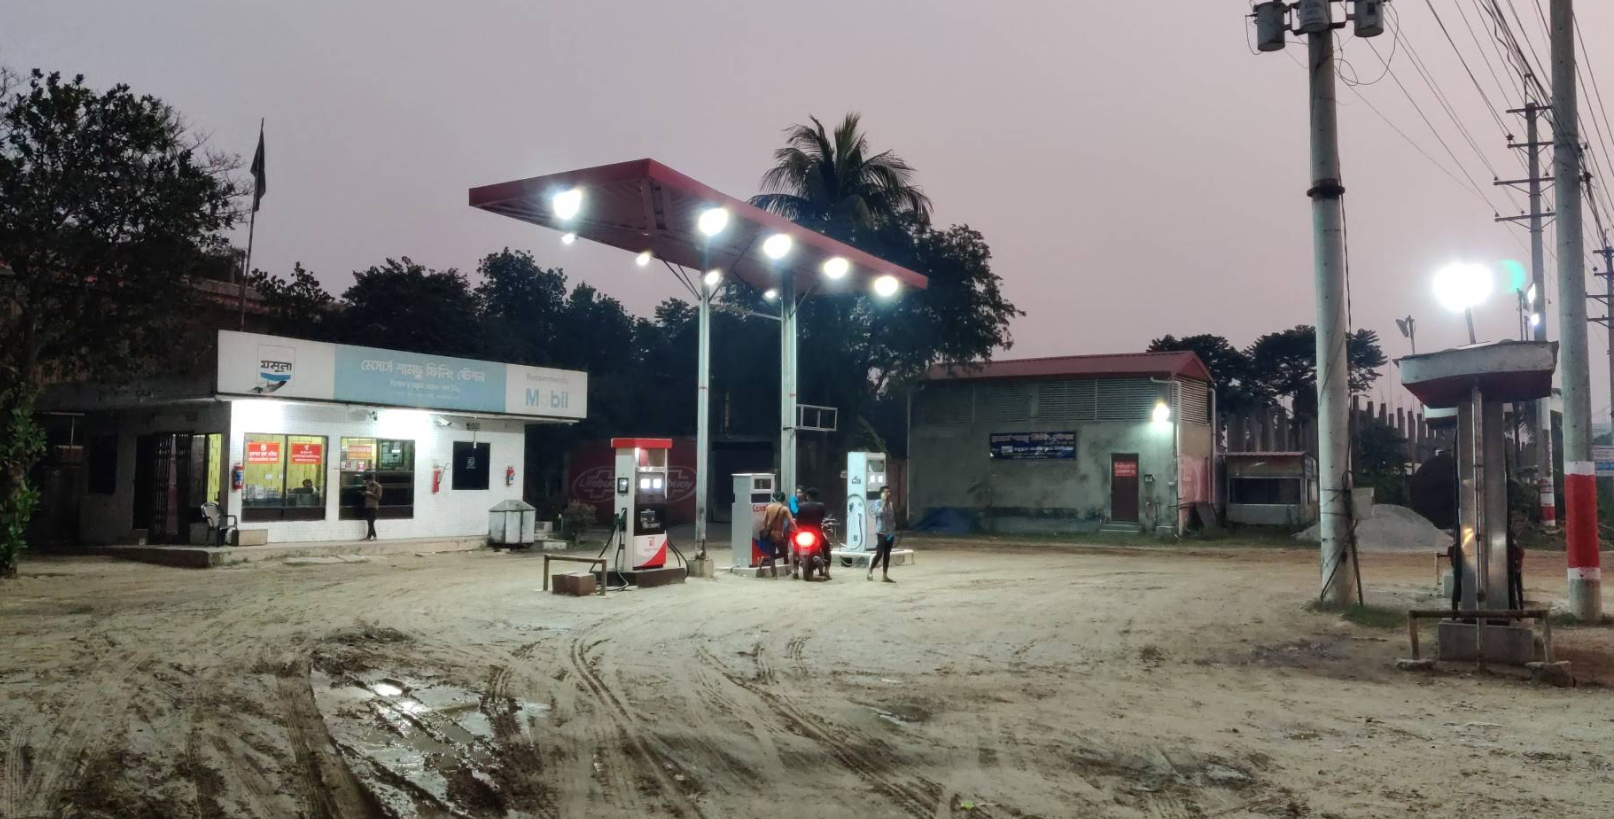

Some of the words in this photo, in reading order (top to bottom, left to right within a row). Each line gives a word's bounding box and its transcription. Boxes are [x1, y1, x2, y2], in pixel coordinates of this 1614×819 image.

[426, 363, 454, 380] ফিলিং
[457, 367, 485, 382] স্টেশন
[525, 388, 569, 409] Mobil
